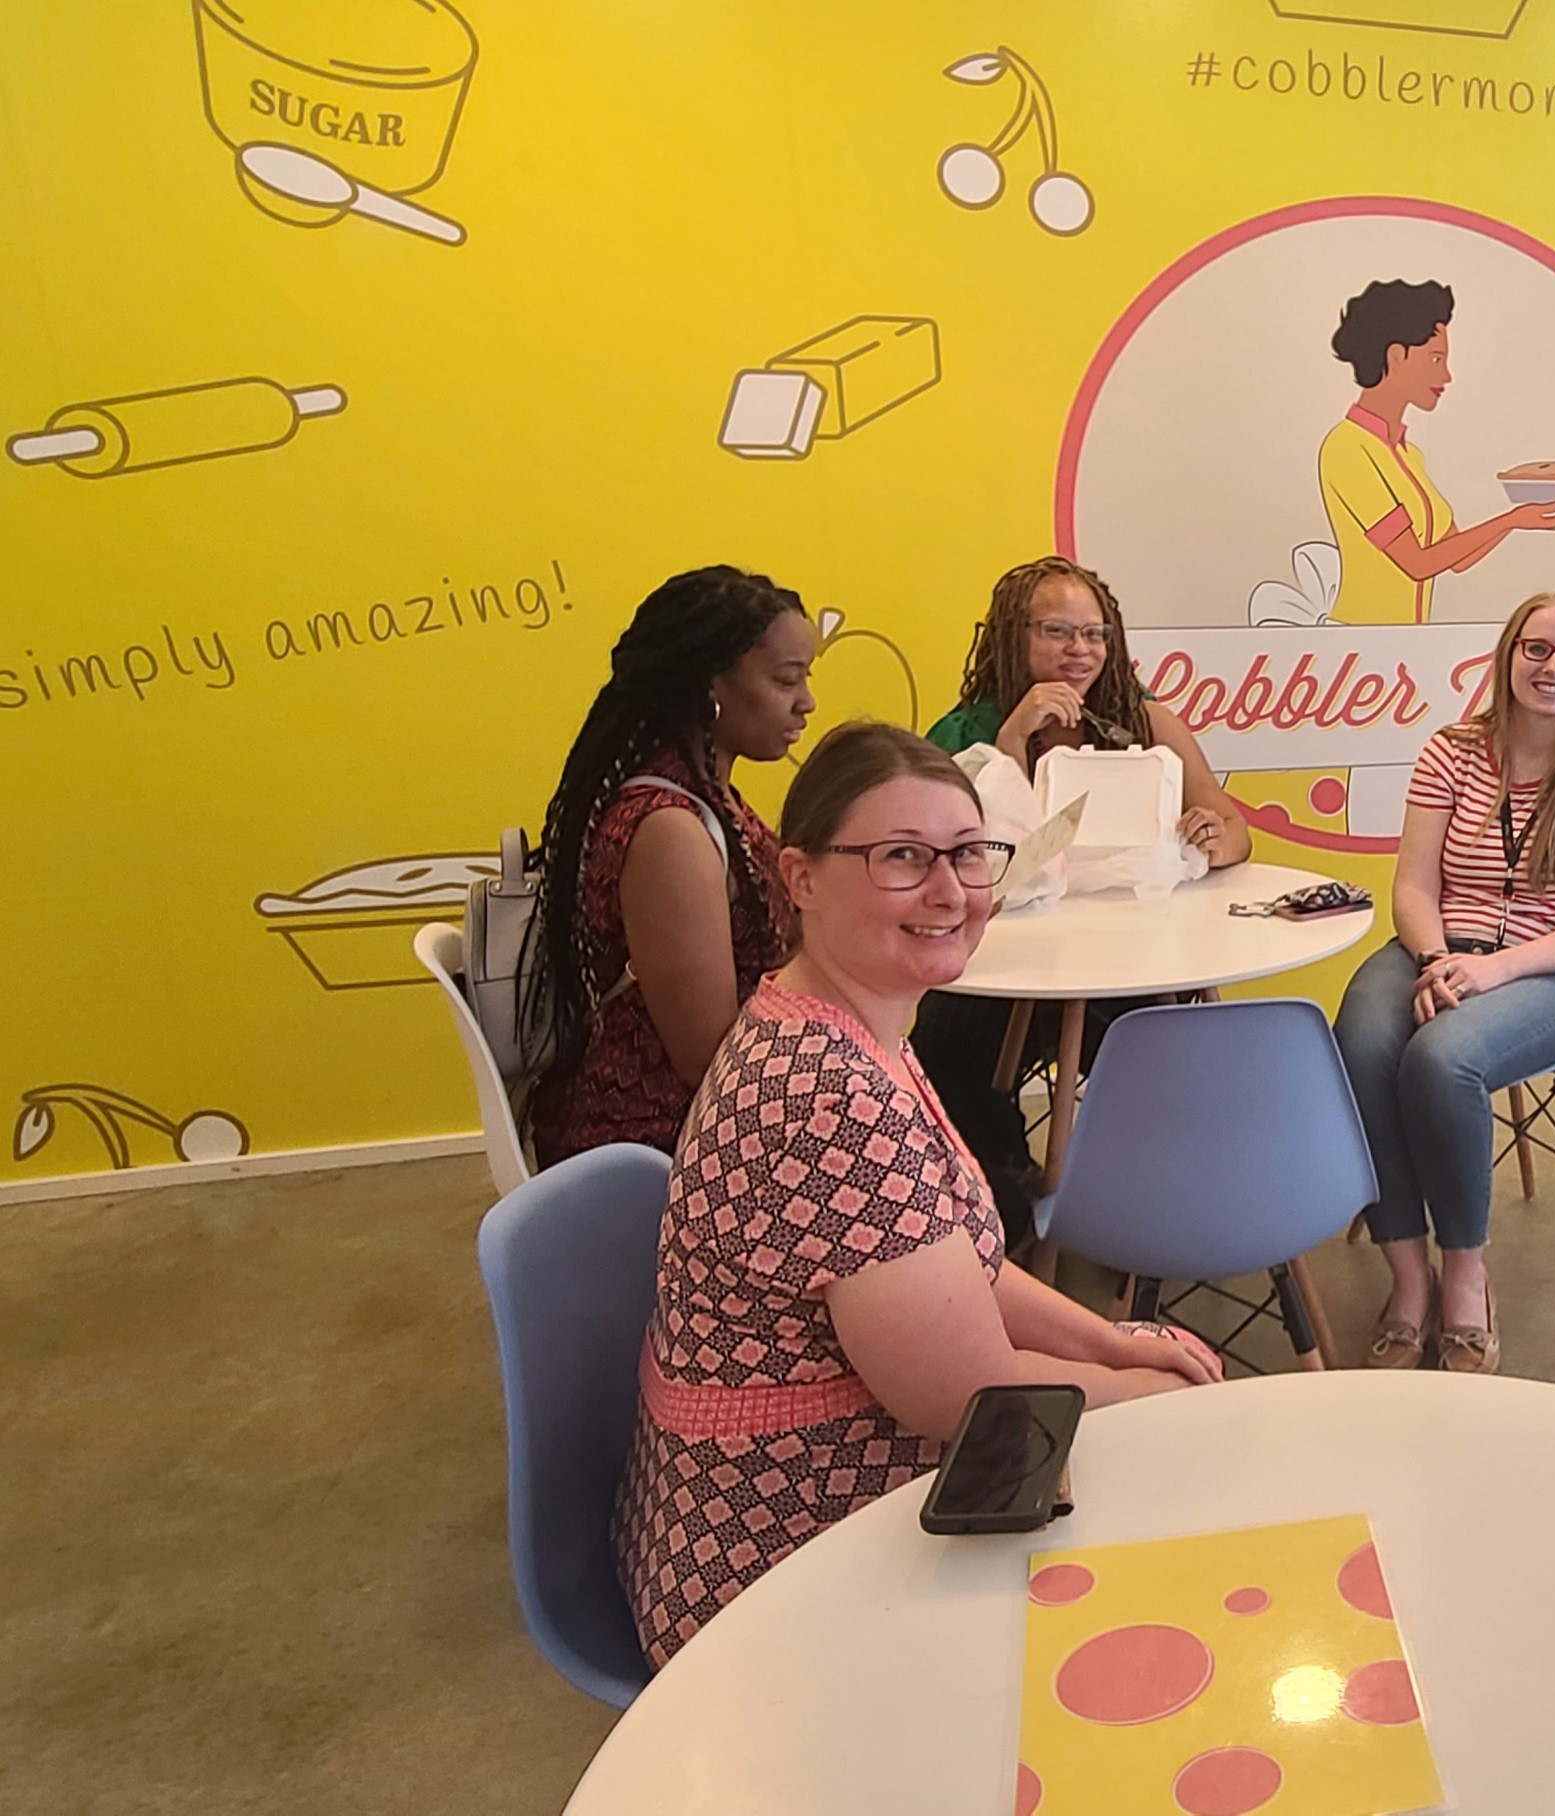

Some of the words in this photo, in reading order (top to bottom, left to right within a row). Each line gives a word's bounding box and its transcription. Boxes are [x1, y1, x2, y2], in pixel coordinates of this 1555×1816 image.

[249, 78, 407, 148] SUGAR
[0, 625, 235, 709] simply
[265, 559, 574, 660] amazing!
